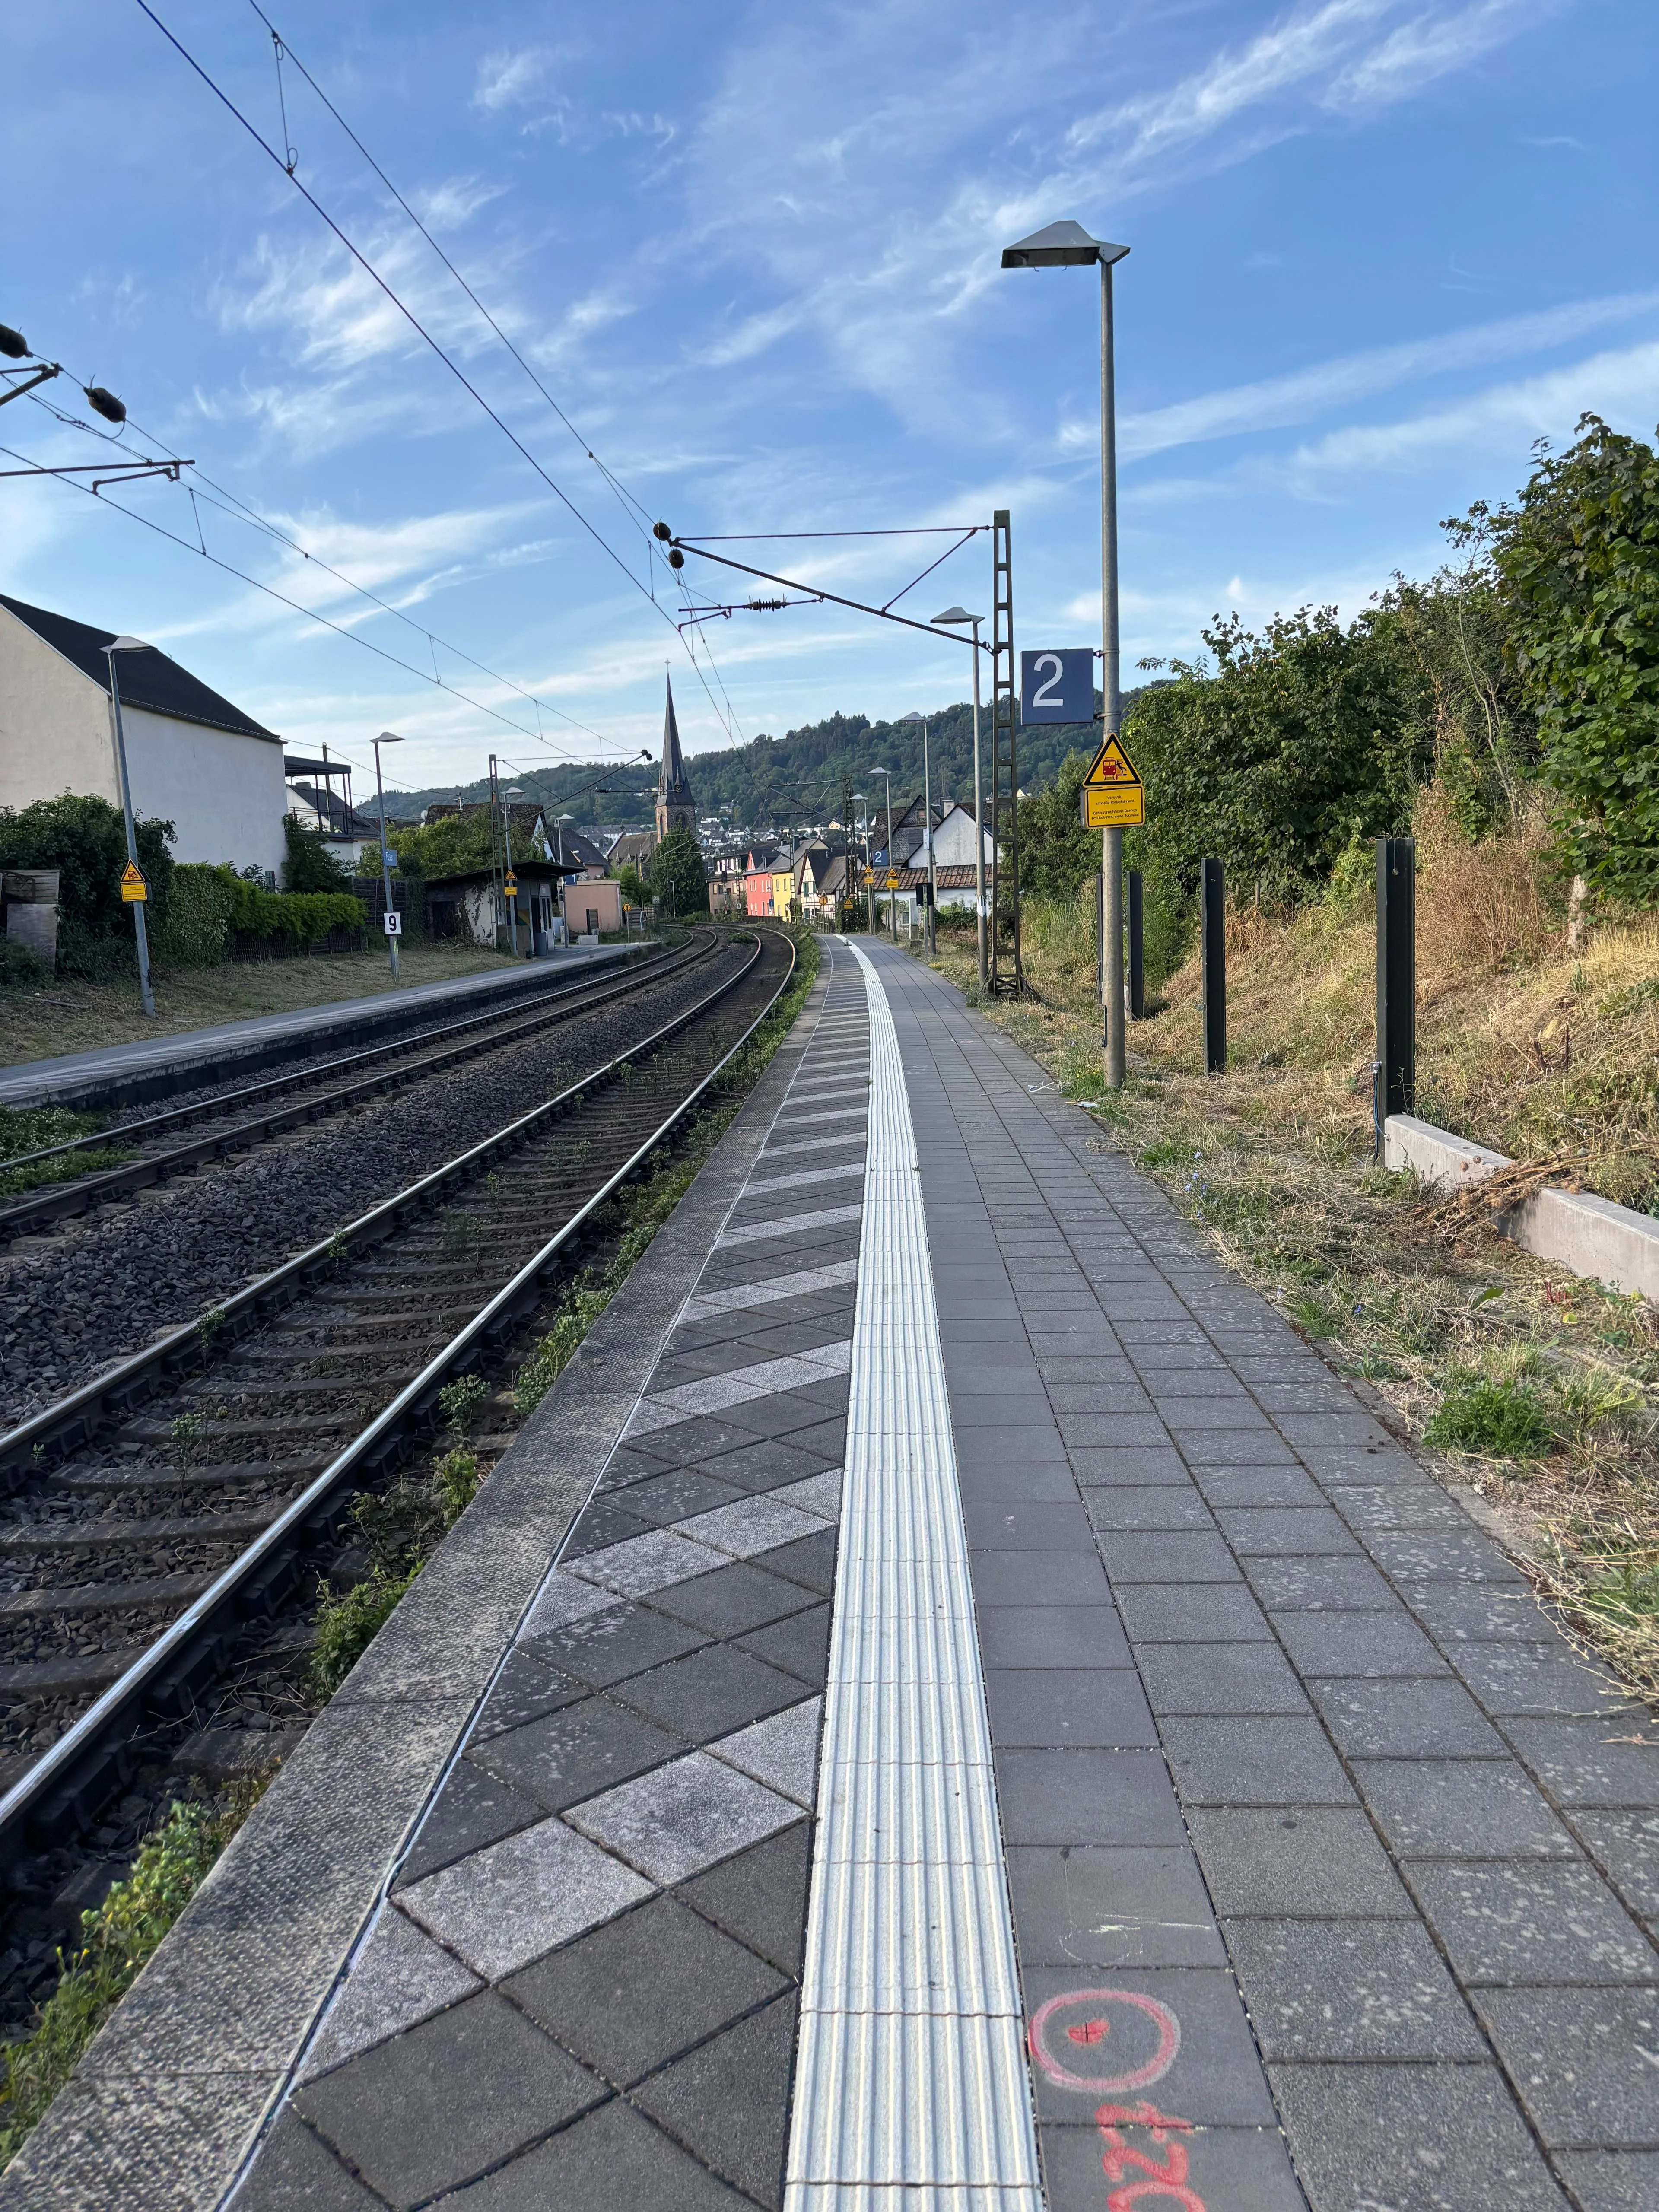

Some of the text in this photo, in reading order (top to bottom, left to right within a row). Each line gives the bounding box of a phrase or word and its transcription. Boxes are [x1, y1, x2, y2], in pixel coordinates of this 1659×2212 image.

[1033, 654, 1063, 707] 2
[875, 851, 882, 862] 2
[389, 915, 397, 931] 9
